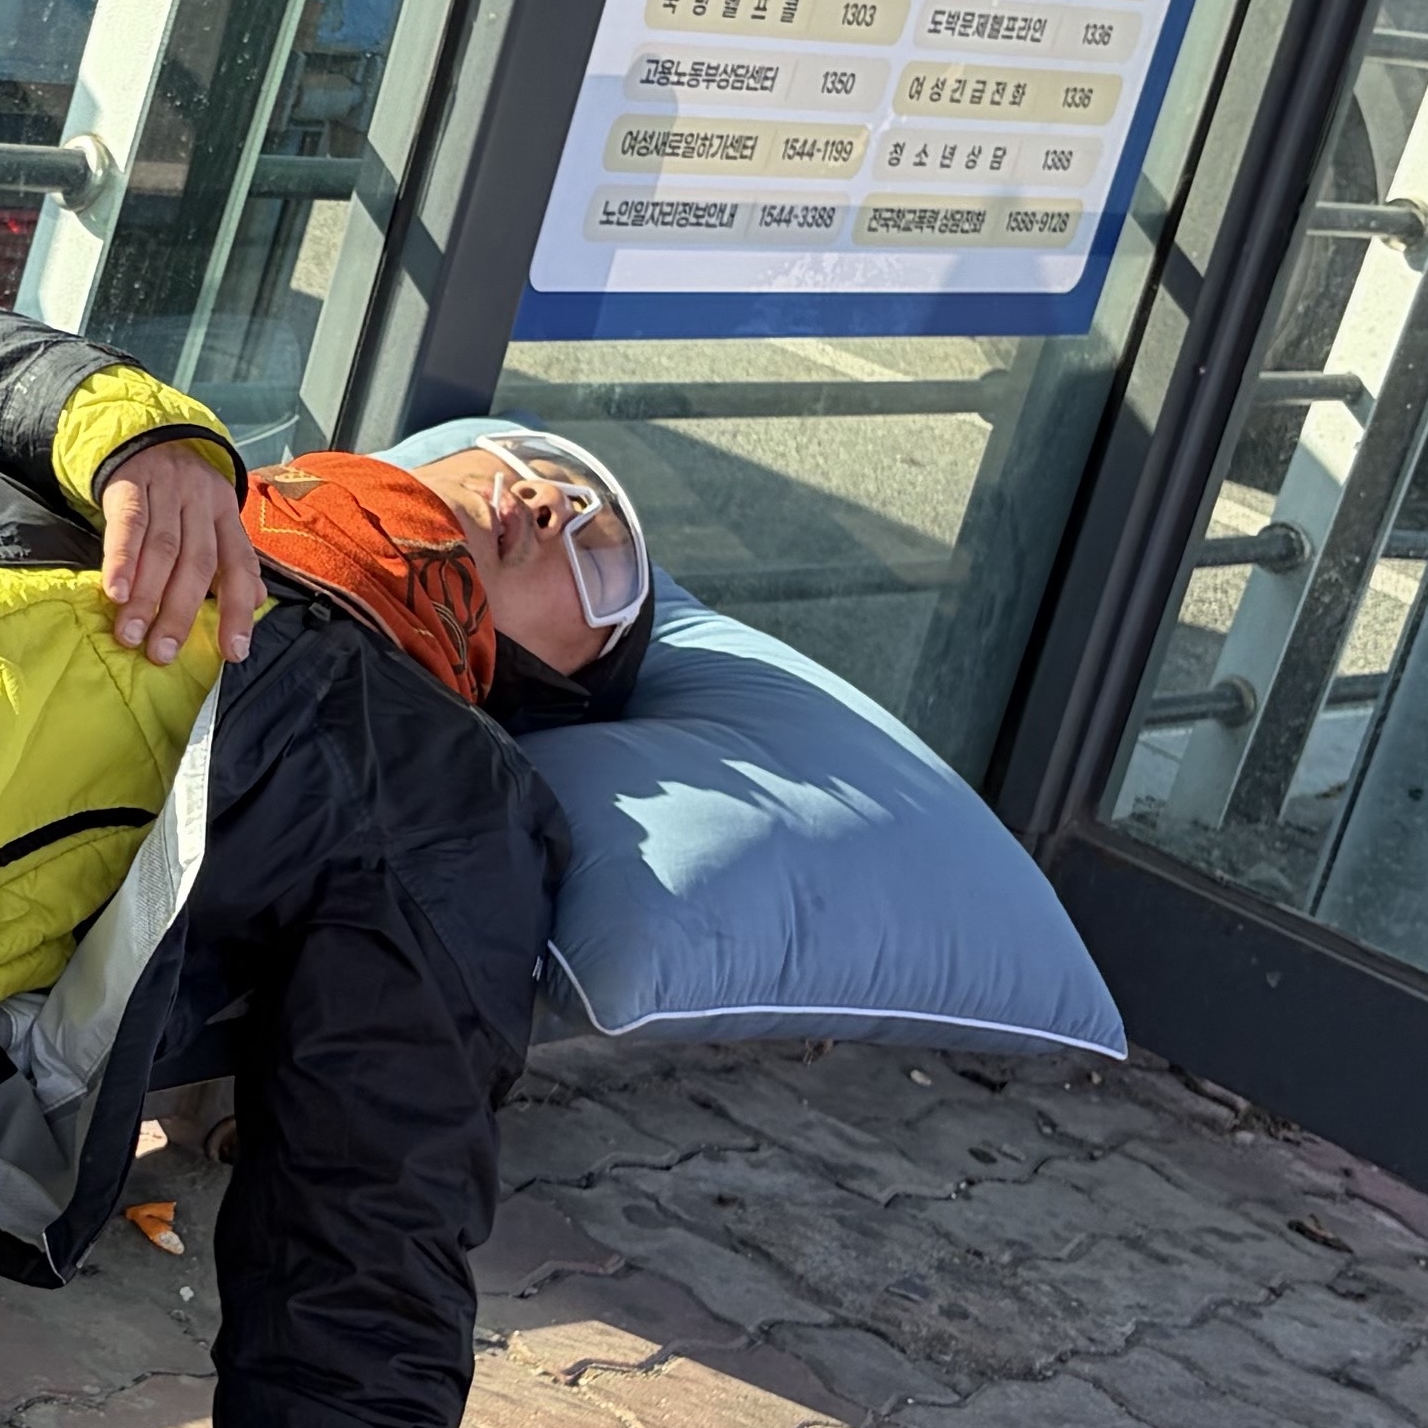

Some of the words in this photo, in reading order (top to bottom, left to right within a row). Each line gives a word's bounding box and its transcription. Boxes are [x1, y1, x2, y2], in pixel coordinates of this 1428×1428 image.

[842, 2, 877, 27] 1303
[1083, 24, 1113, 46] 1336
[640, 58, 779, 93] 고용노동부상담센터
[821, 71, 855, 94] 1350
[782, 138, 853, 162] 1544-1199
[759, 205, 835, 228] 1544-3388
